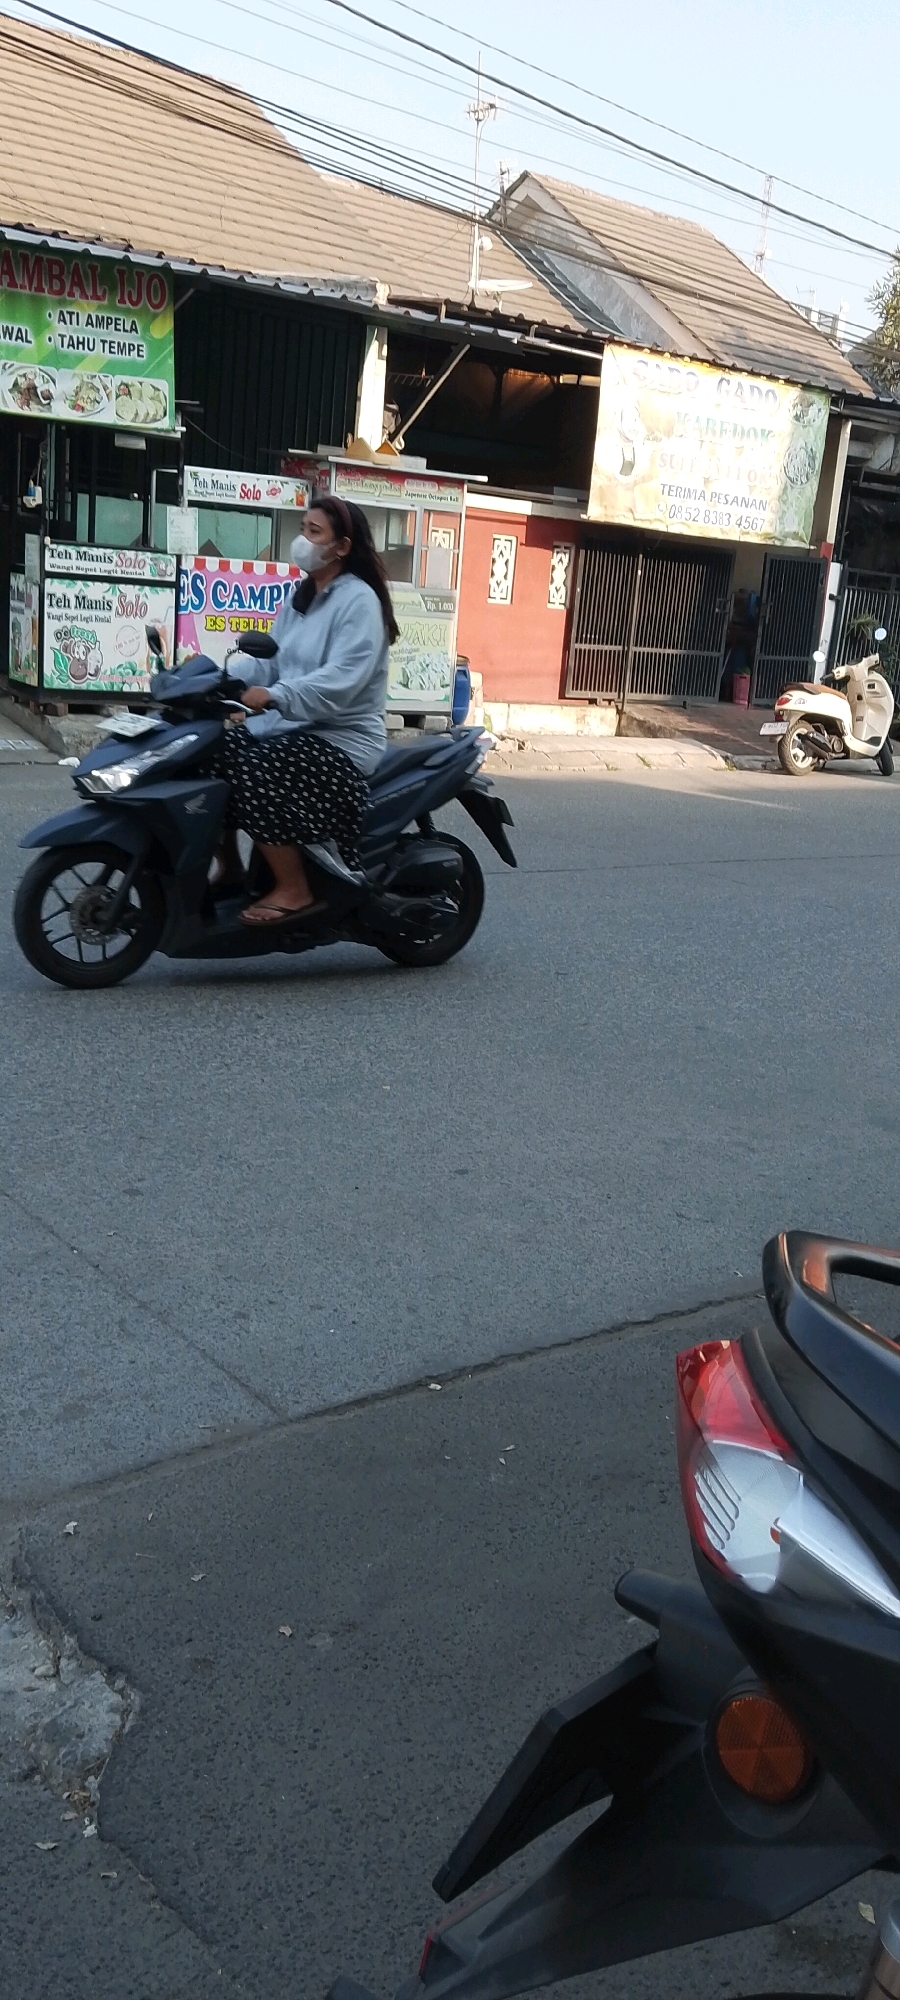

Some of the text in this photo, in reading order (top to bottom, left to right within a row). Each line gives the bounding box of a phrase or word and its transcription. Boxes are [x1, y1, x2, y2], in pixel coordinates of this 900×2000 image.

[0, 250, 167, 310] AMBAL IJO
[58, 310, 139, 334] ATI AMPELA
[0, 324, 145, 359] WAL TAHU TEMPE
[716, 376, 778, 405] GADO
[211, 478, 237, 491] Manis
[239, 482, 262, 501] Solo
[661, 483, 768, 511] TERIMA PESANAN
[668, 504, 766, 532] 0852 8383 4567
[48, 549, 146, 570] Teh Manis Solo
[178, 568, 206, 614] ES
[47, 593, 71, 609] Teh
[74, 595, 113, 611] Manis
[115, 593, 148, 619] Solo
[205, 615, 226, 631] ES
